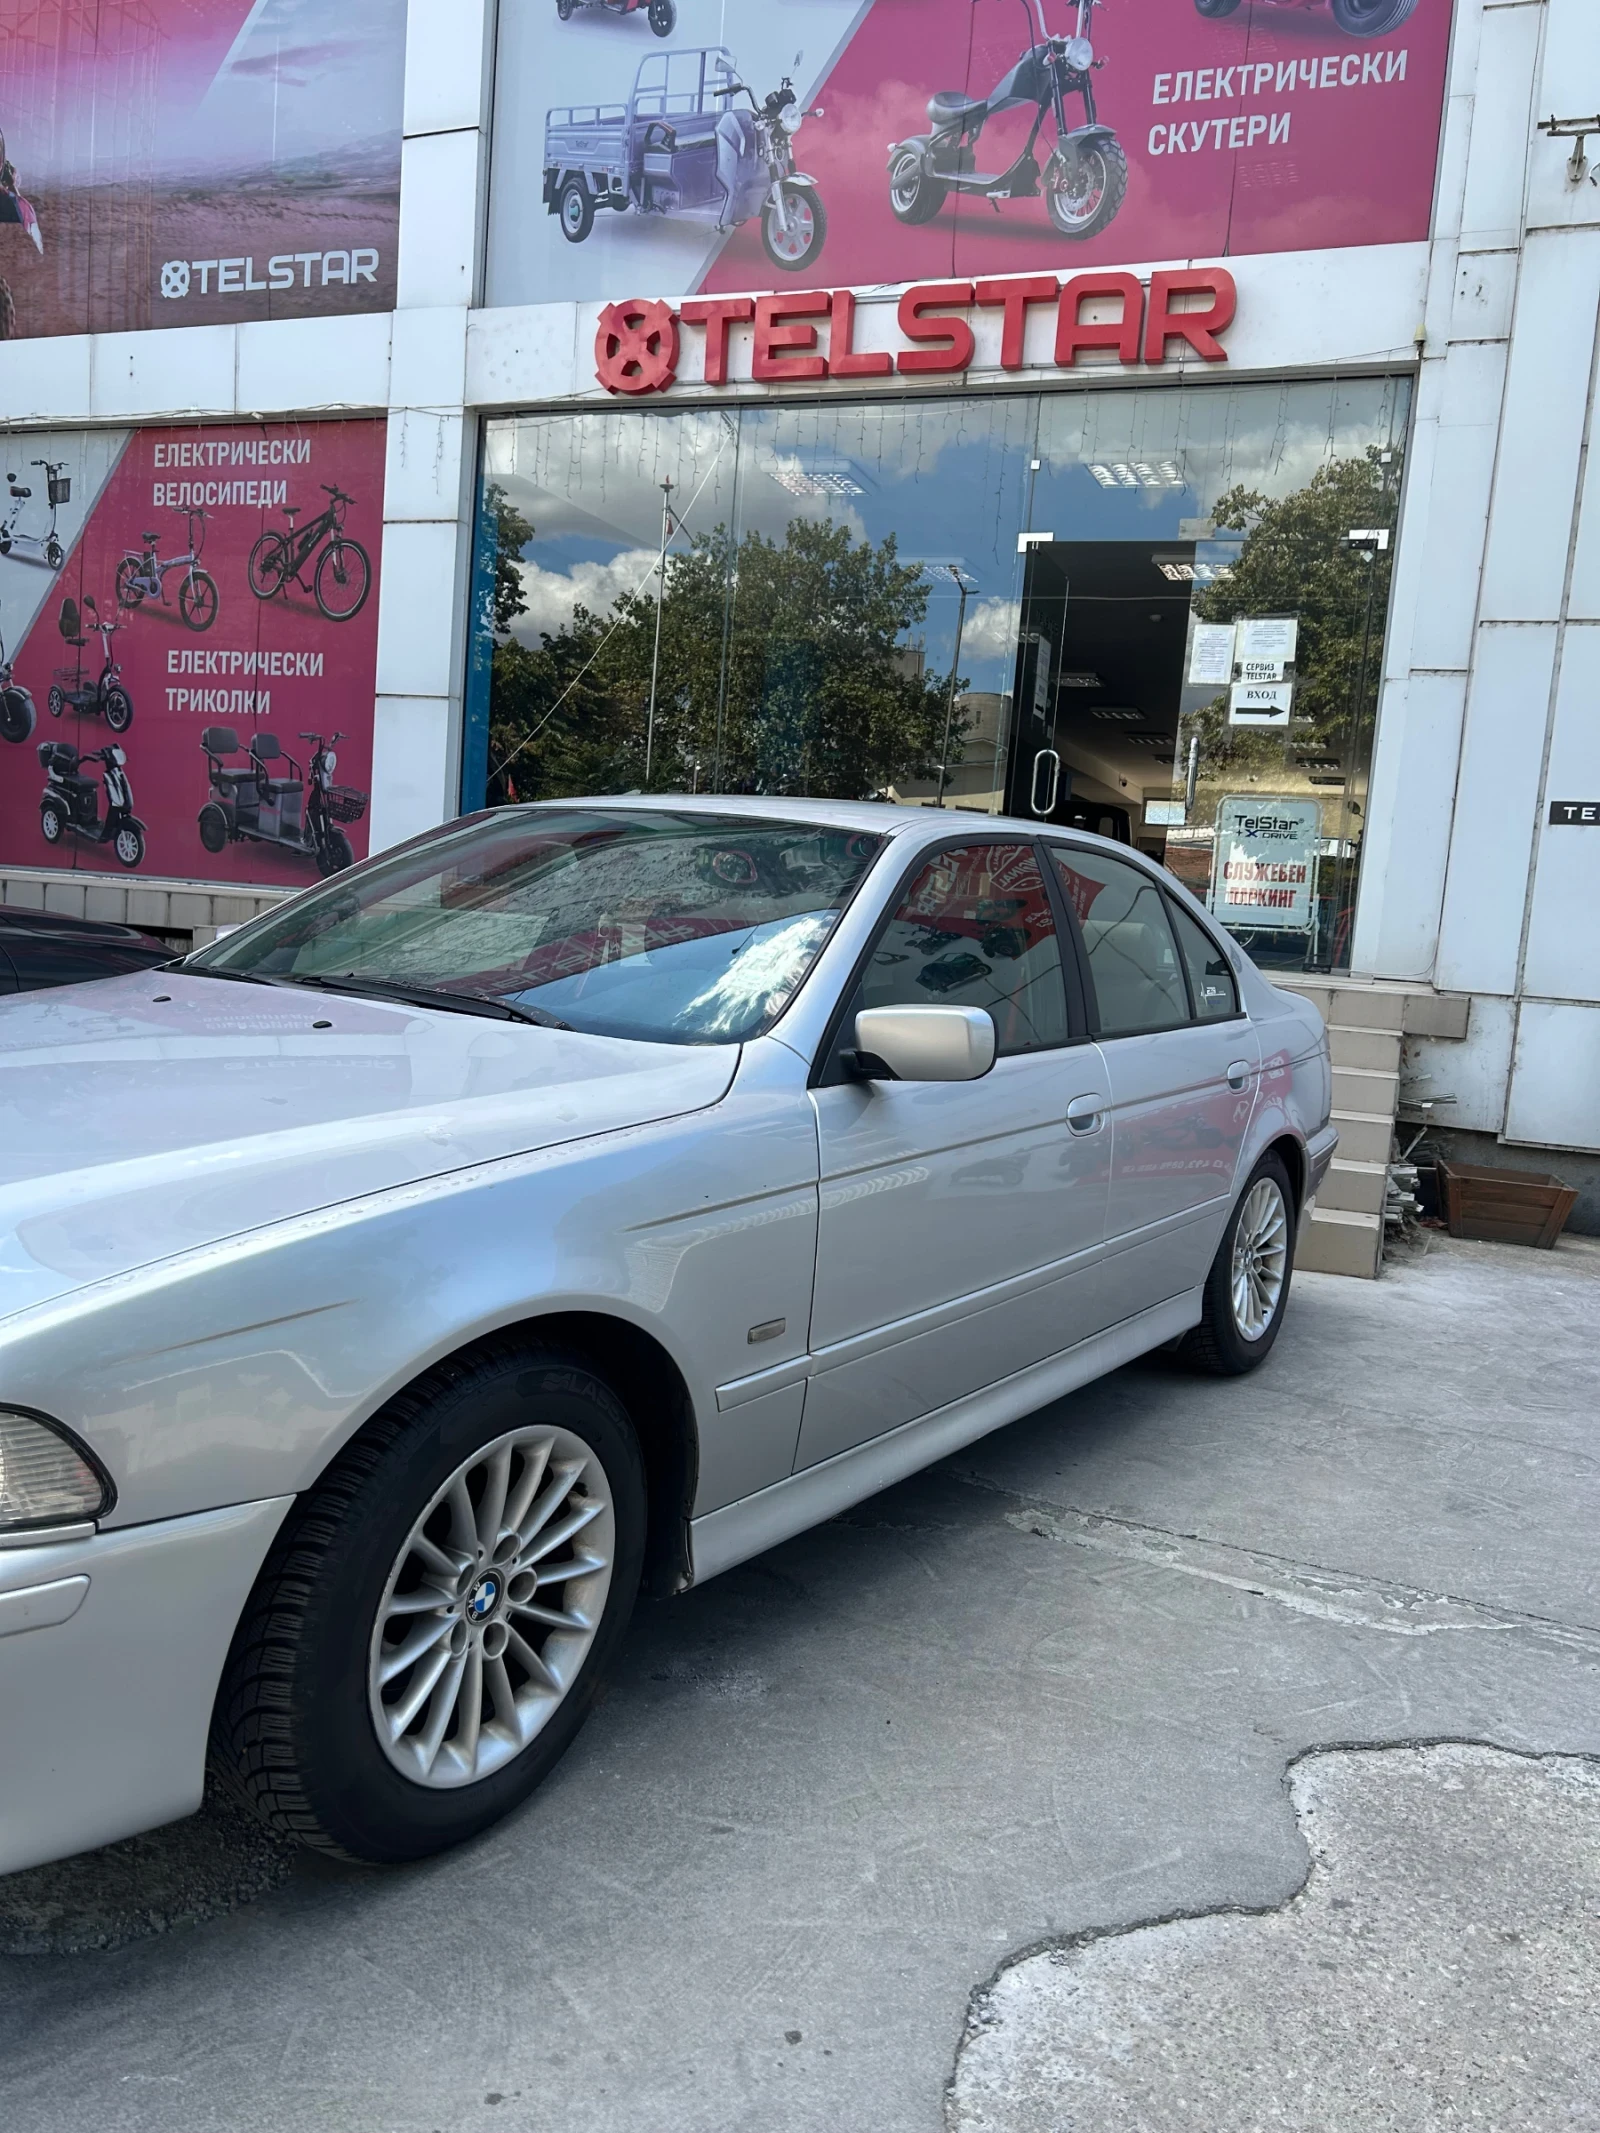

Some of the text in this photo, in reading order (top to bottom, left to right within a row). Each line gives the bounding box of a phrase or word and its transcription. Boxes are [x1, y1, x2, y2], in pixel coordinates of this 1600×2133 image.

[1152, 49, 1408, 105] ЕЛЕКТРИЧЕСКИ
[1147, 112, 1291, 156] СКУТЕРИ
[191, 248, 380, 294] TELSTAR
[680, 267, 1236, 387] TELSTAR
[154, 439, 312, 468] ЕЛЕКТРИЧЕСКИ
[153, 480, 287, 509] ВЕЛОСИПЕДИ
[167, 650, 324, 677] ЕЛЕКТРИЧЕСКИ
[1246, 663, 1275, 671] СЕРВИЗ
[1246, 672, 1277, 680] TELSTAR
[165, 688, 271, 714] ТРИКОЛКИ
[1246, 690, 1277, 700] ВХОД
[1262, 832, 1298, 840] DRIVE
[1223, 861, 1307, 883] СЛУЖЕБЕН
[1229, 886, 1297, 908] ПАРКИНГ
[467, 1581, 481, 1620] BMW
